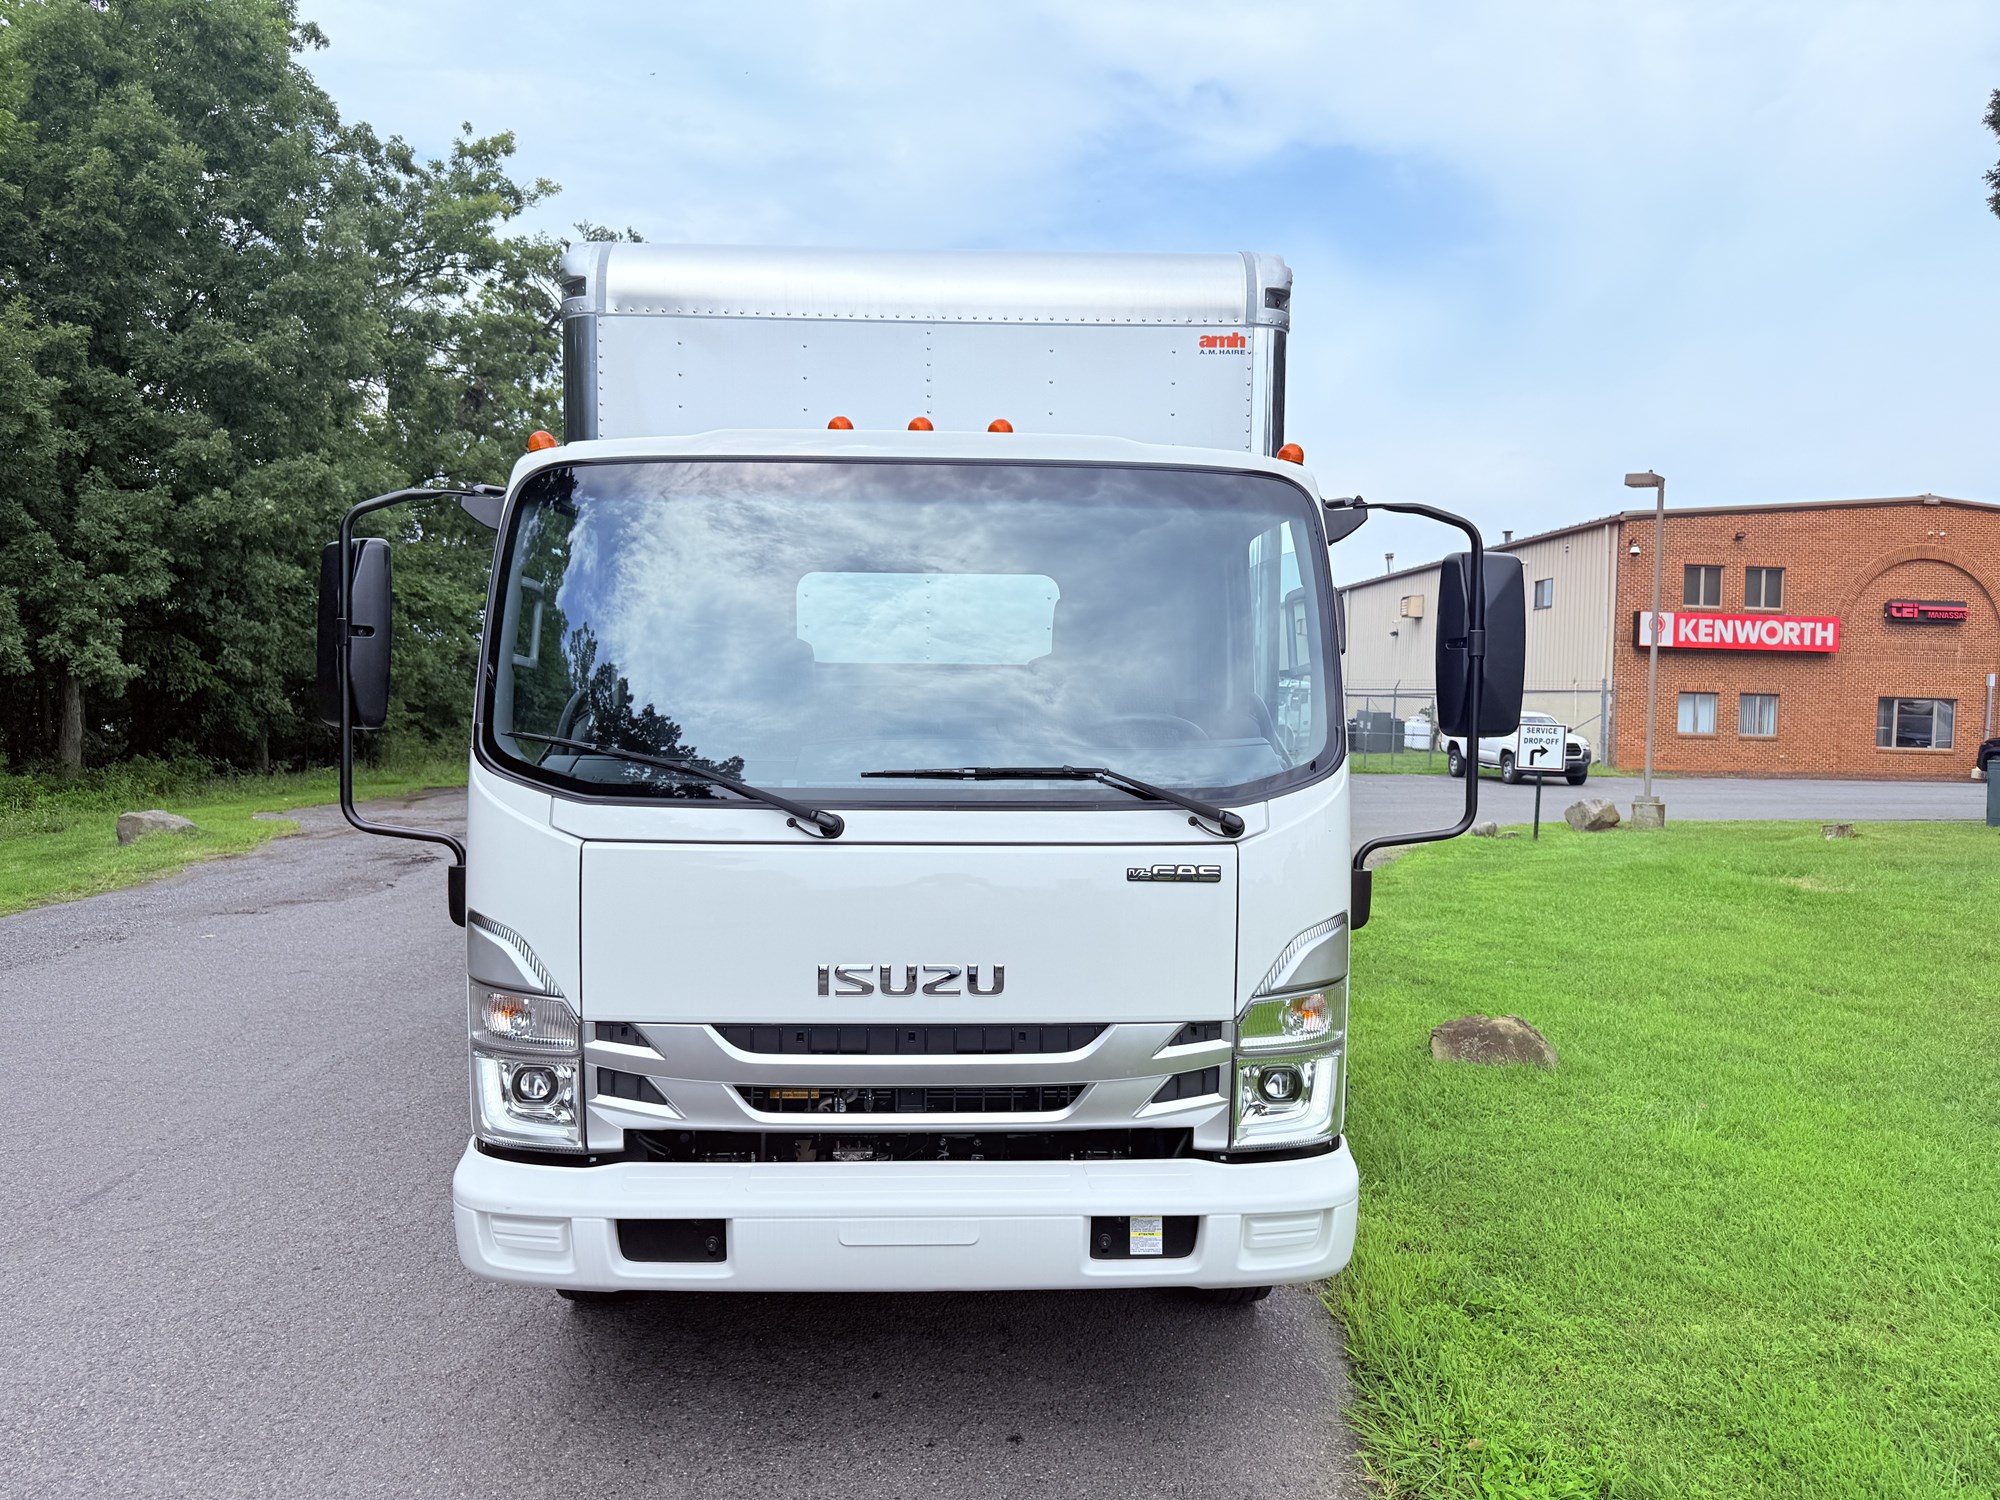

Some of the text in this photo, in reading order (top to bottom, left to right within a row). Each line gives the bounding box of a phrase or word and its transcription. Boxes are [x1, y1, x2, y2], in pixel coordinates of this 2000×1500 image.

[1199, 332, 1246, 348] amh
[1927, 611, 1968, 619] MANASSAS
[1678, 618, 1834, 646] KENWORTH
[1523, 737, 1559, 745] DROP-OFF
[818, 963, 1005, 997] ISUZU
